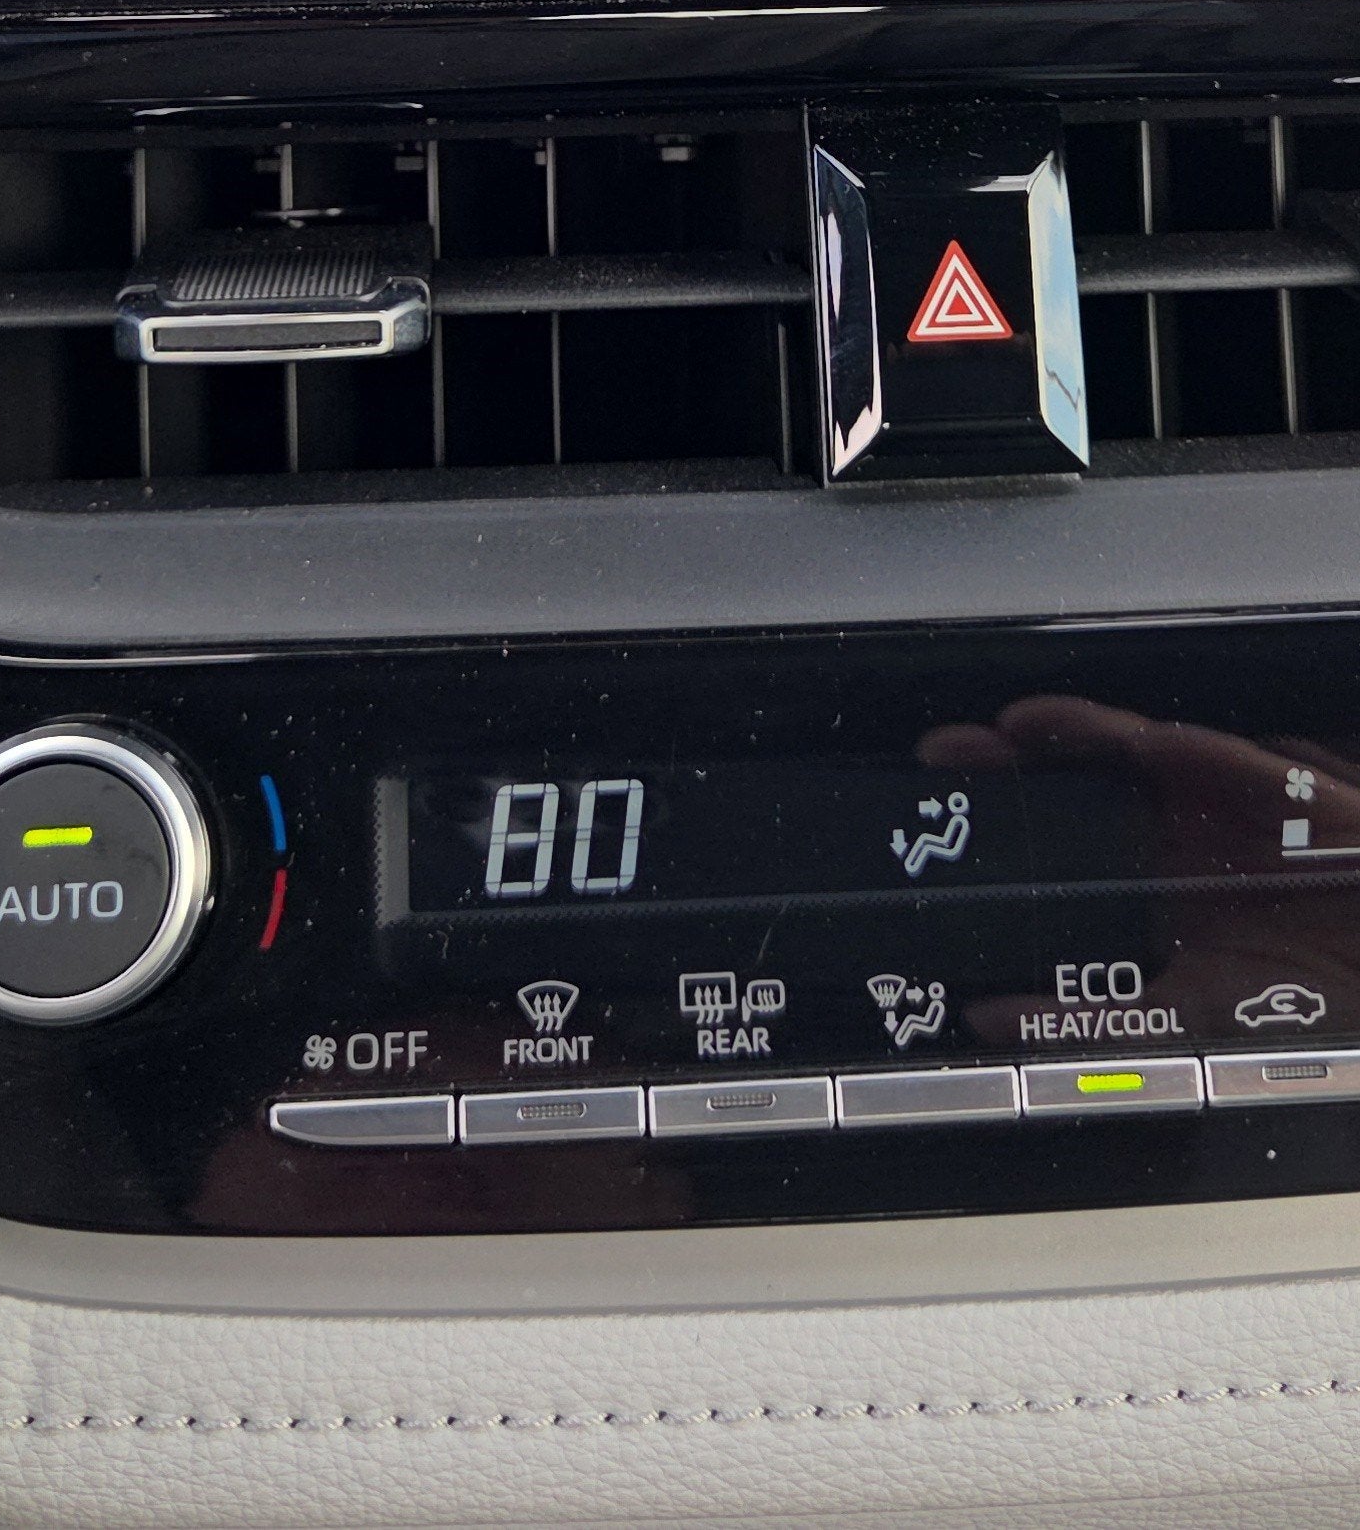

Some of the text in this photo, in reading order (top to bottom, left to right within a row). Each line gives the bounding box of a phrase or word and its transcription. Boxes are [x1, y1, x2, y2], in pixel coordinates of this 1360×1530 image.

[484, 778, 645, 898] 80
[1055, 960, 1143, 1004] ECO
[696, 1028, 771, 1057] REAR
[1019, 1007, 1186, 1041] HEAT/COOL
[346, 1030, 428, 1071] OFF
[503, 1033, 594, 1066] FRONT
